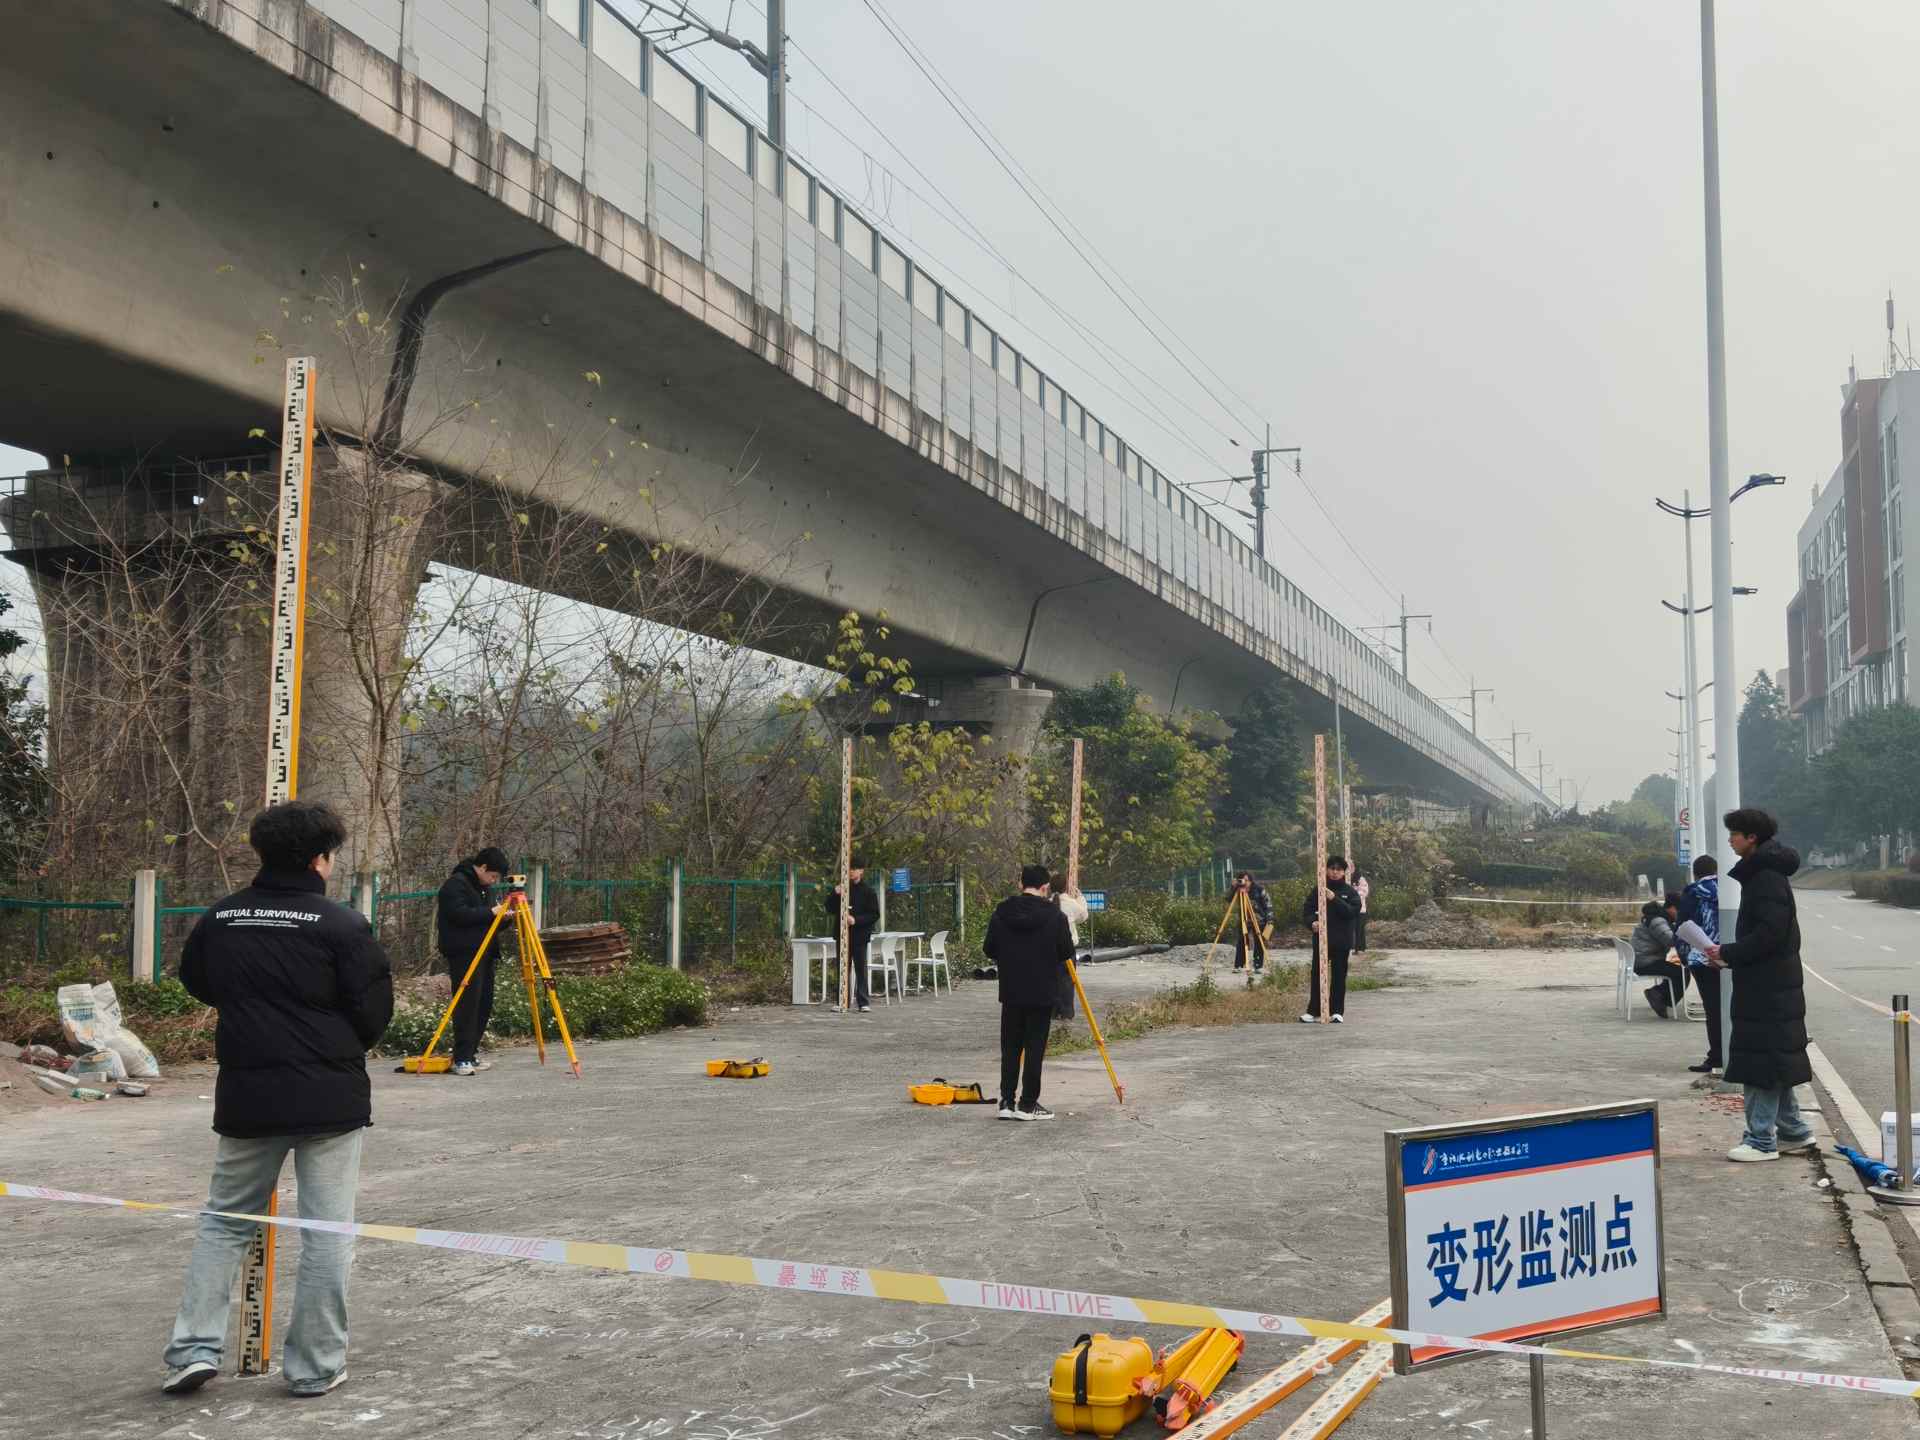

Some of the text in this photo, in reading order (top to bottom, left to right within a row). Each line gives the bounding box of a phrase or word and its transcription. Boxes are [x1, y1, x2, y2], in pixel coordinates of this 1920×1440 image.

[215, 908, 322, 922] VIRTUAL SURVIVALIST
[1426, 1194, 1638, 1309] 变形监测点
